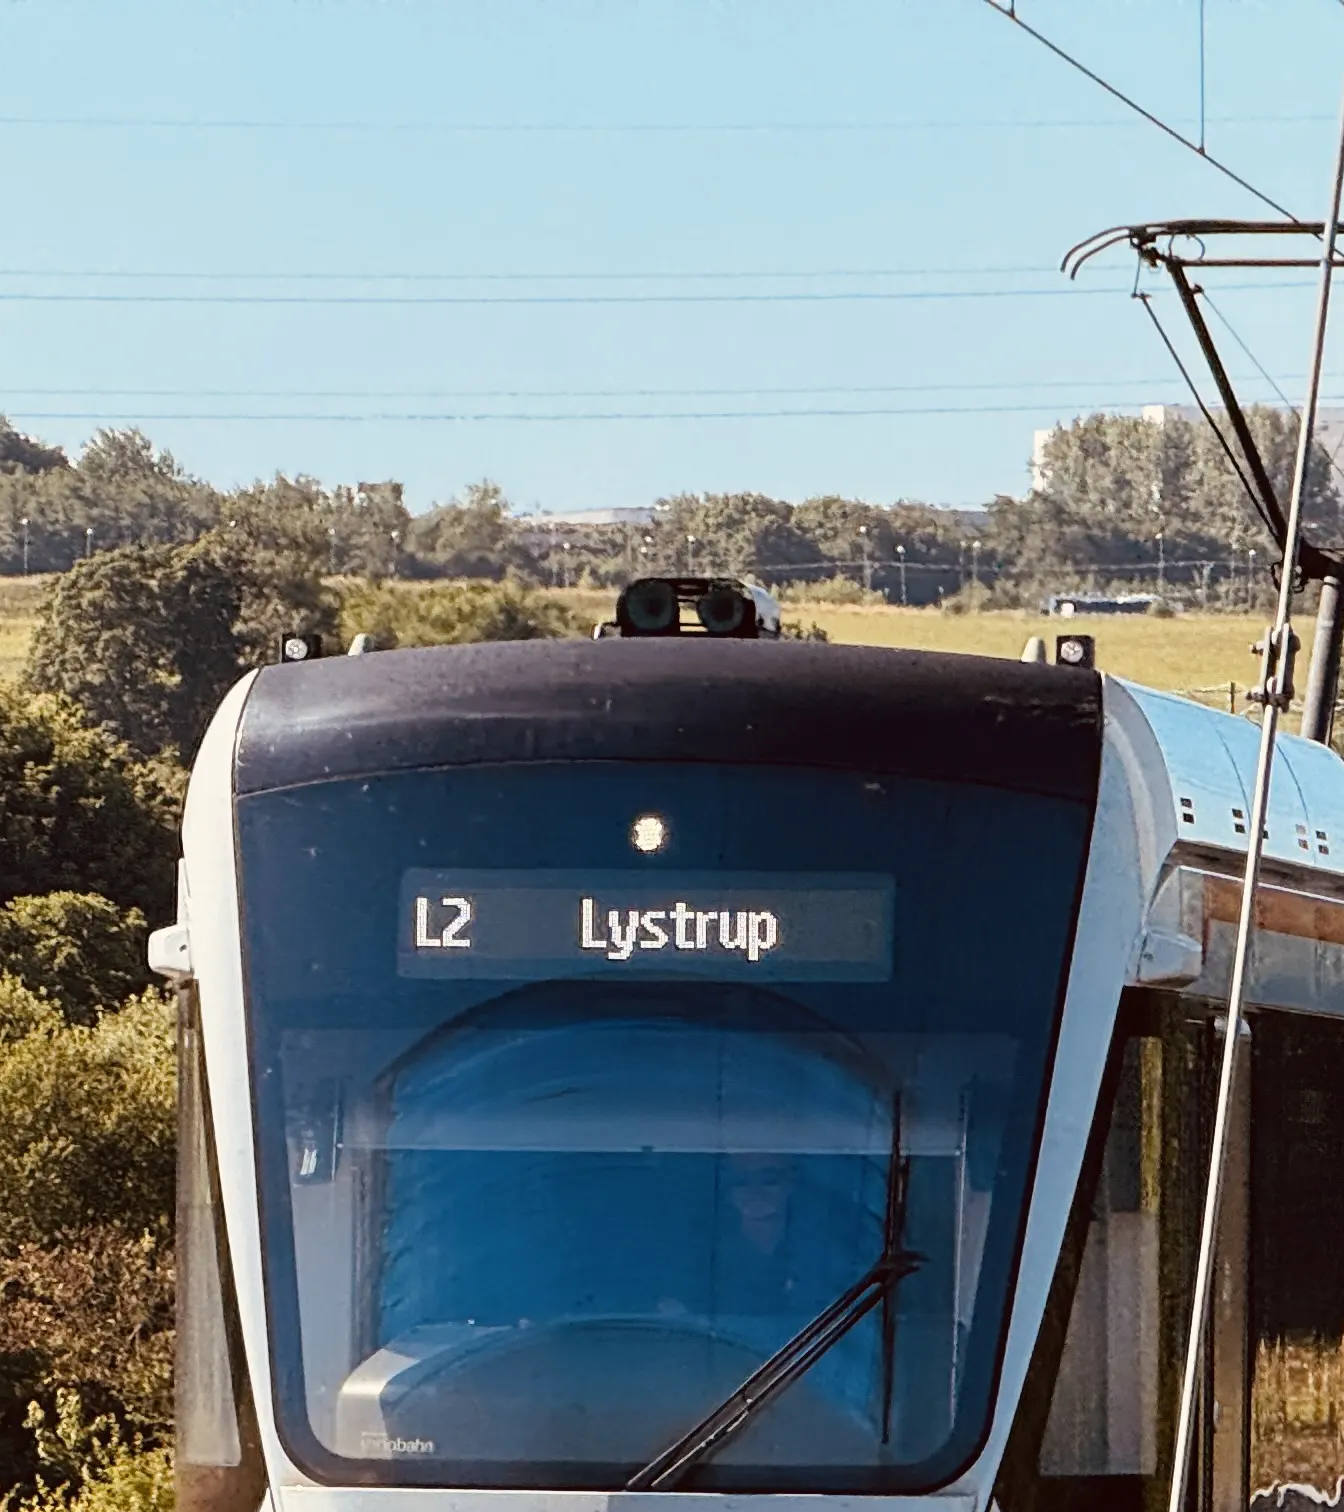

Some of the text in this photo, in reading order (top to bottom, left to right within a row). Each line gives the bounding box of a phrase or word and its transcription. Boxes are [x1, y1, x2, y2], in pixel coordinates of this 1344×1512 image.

[416, 897, 779, 961] L2 Lystrup
[360, 1437, 434, 1453] iobahn
